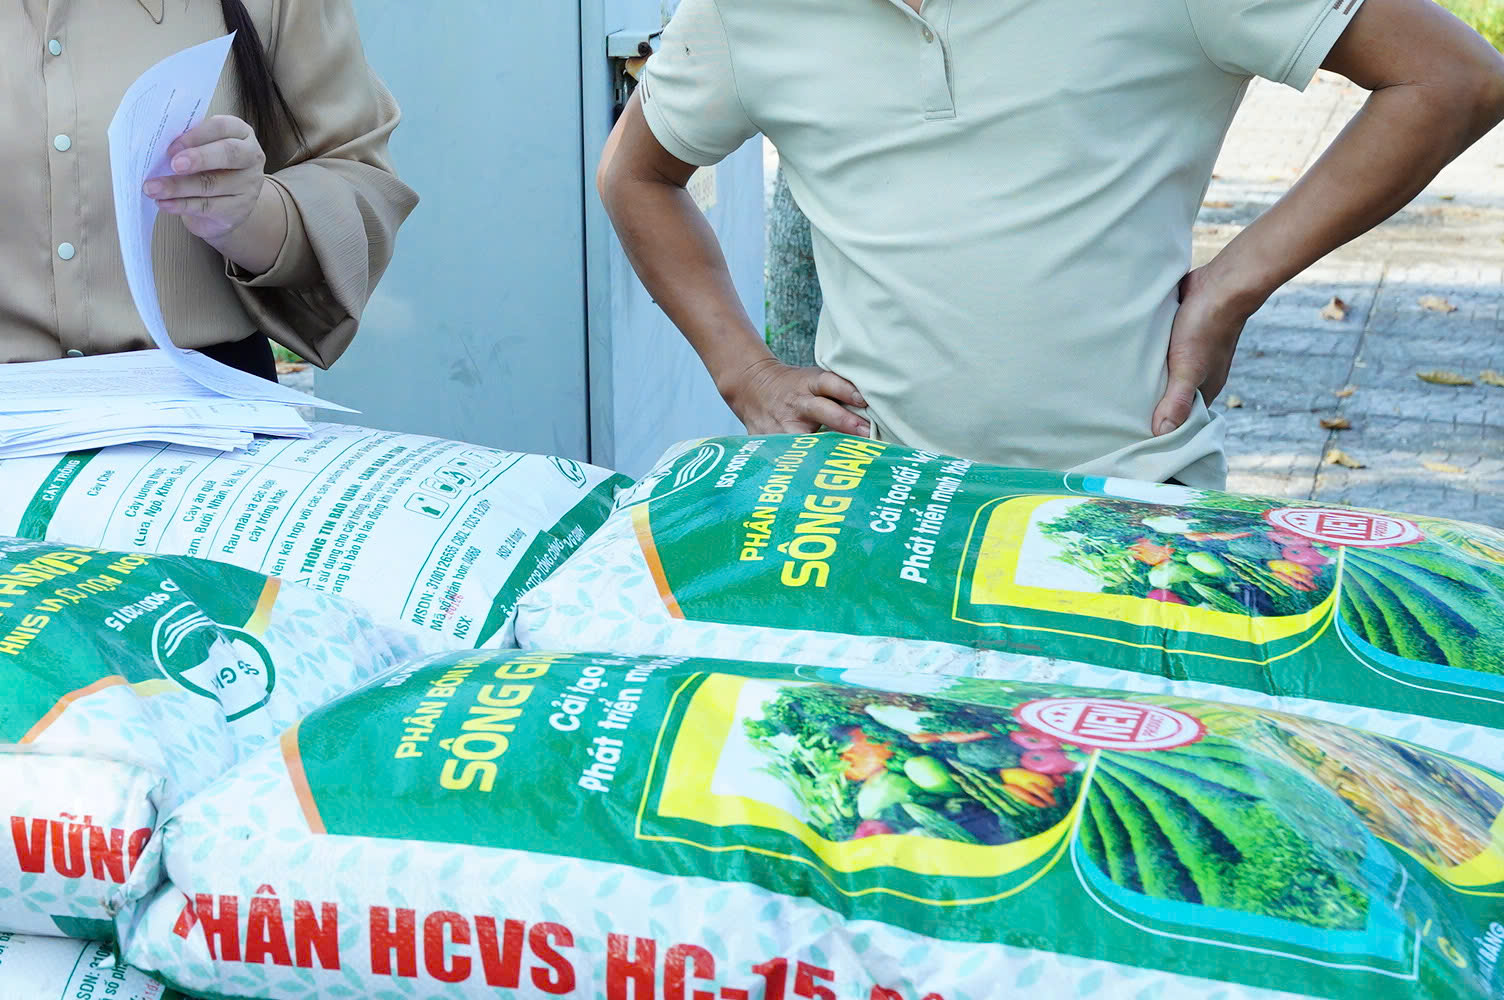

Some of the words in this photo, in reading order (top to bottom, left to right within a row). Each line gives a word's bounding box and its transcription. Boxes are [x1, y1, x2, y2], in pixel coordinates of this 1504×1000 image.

[775, 445, 810, 473] HỮU
[813, 438, 890, 491] GIANH
[42, 483, 59, 501] CÂY
[55, 459, 81, 486] TRỒNG
[86, 481, 108, 497] Cây
[715, 473, 739, 488] ISO
[761, 473, 793, 505] BÓN
[890, 465, 923, 485] đất
[931, 476, 965, 503] mạnh
[124, 502, 141, 518] Cây
[134, 479, 157, 504] lương
[182, 505, 200, 523] Cây
[201, 479, 218, 498] quả
[269, 488, 289, 506] khác
[340, 483, 363, 502] QUẢN
[880, 483, 917, 506] tạo
[132, 517, 153, 547] (Lúa,
[144, 495, 166, 519] Ngô,
[194, 510, 217, 535] Bưởi,
[206, 488, 230, 513] Nhãn,
[222, 529, 241, 554] Rau
[234, 510, 253, 532] màu
[252, 488, 269, 504] các
[256, 502, 280, 527] trồng
[278, 539, 296, 557] kết
[287, 520, 306, 541] hợp
[298, 506, 314, 522] với
[307, 494, 323, 508] các
[327, 502, 349, 520] BẢO
[367, 502, 389, 521] động
[869, 505, 903, 533] Cải
[909, 503, 949, 535] triển
[248, 522, 266, 543] cây
[318, 519, 338, 536] TIN
[334, 532, 350, 548] cho
[342, 518, 360, 534] cây
[352, 531, 369, 545] hộ
[358, 519, 376, 533] lao
[739, 503, 779, 562] PHÂN
[777, 493, 854, 588] SÔNG
[1322, 513, 1370, 539] NEW
[299, 536, 328, 573] THÔNG
[322, 547, 345, 571] dụng
[343, 543, 362, 561] bảo
[496, 545, 513, 561] HSD:
[899, 536, 937, 584] Phát
[317, 567, 332, 583] sử
[426, 544, 460, 591] 3100126555
[429, 612, 447, 632] Mã
[444, 580, 463, 603] phân
[452, 614, 474, 640] NSX:
[566, 665, 609, 696] tạo
[394, 699, 449, 760] PHÂN
[424, 667, 473, 698] BÓN
[549, 693, 591, 732] Cải
[596, 687, 644, 731] triển
[1077, 706, 1145, 741] NEW
[439, 684, 535, 793] SÔNG
[577, 735, 624, 793] Phát
[173, 884, 341, 970] HÂN
[369, 902, 577, 995] HCVS
[605, 932, 838, 1000] HC-15
[75, 969, 102, 1000] SDN:
[104, 978, 121, 996] số
